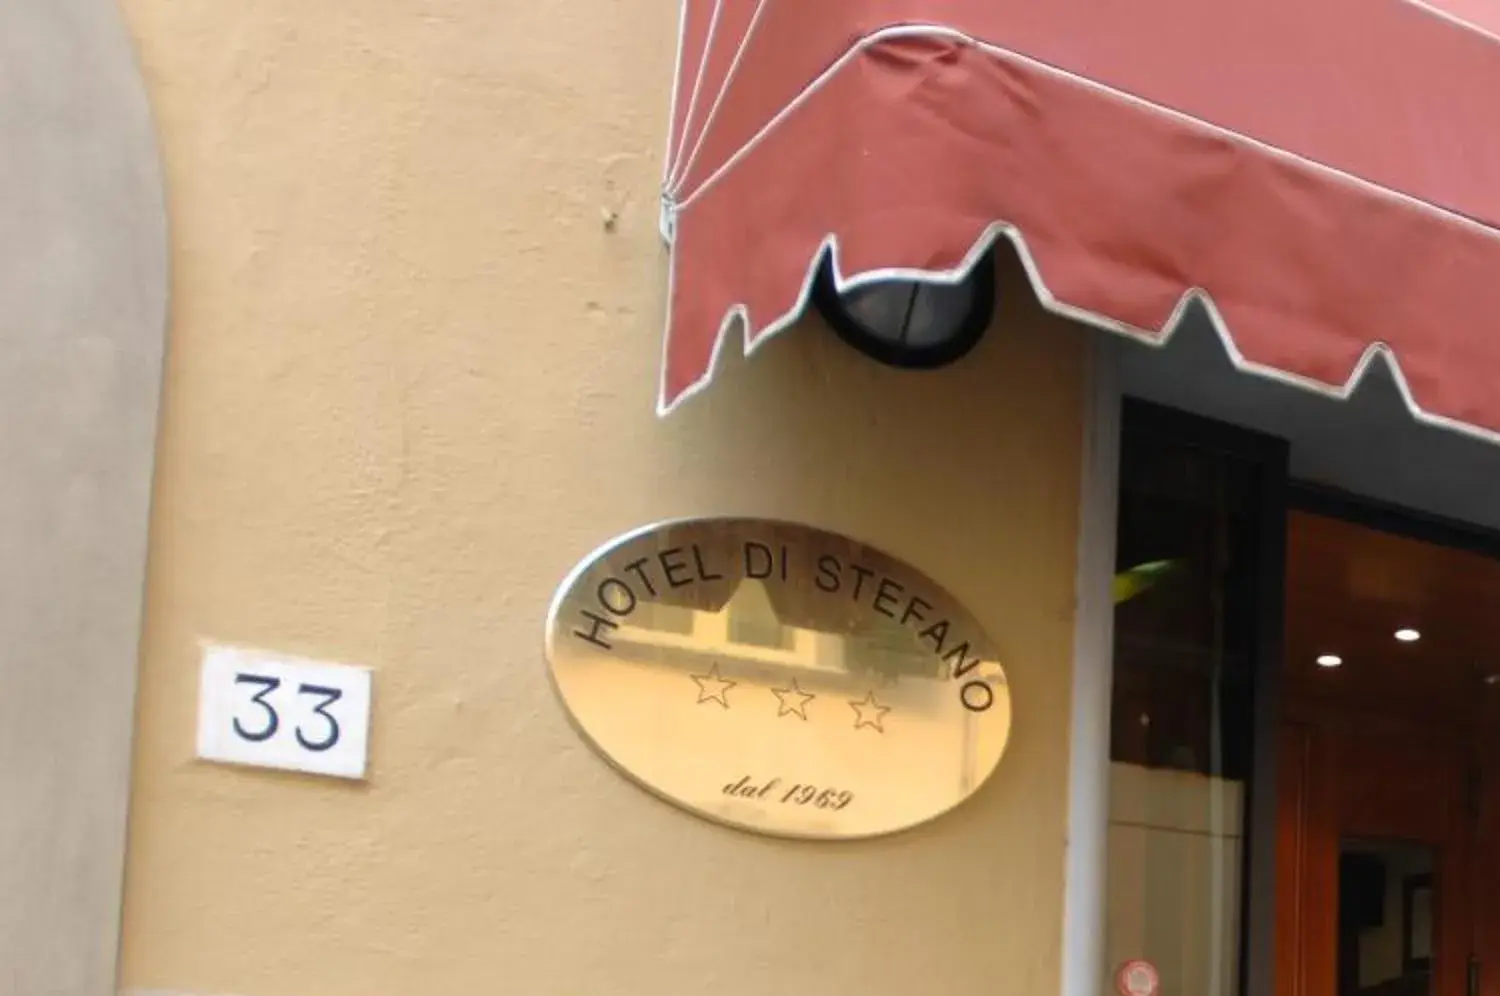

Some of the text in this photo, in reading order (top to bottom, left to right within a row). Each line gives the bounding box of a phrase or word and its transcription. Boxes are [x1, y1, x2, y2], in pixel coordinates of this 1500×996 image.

[573, 541, 994, 713] HOTEL DI STEFANO
[232, 673, 343, 752] 33
[722, 775, 855, 812] dal 1969
